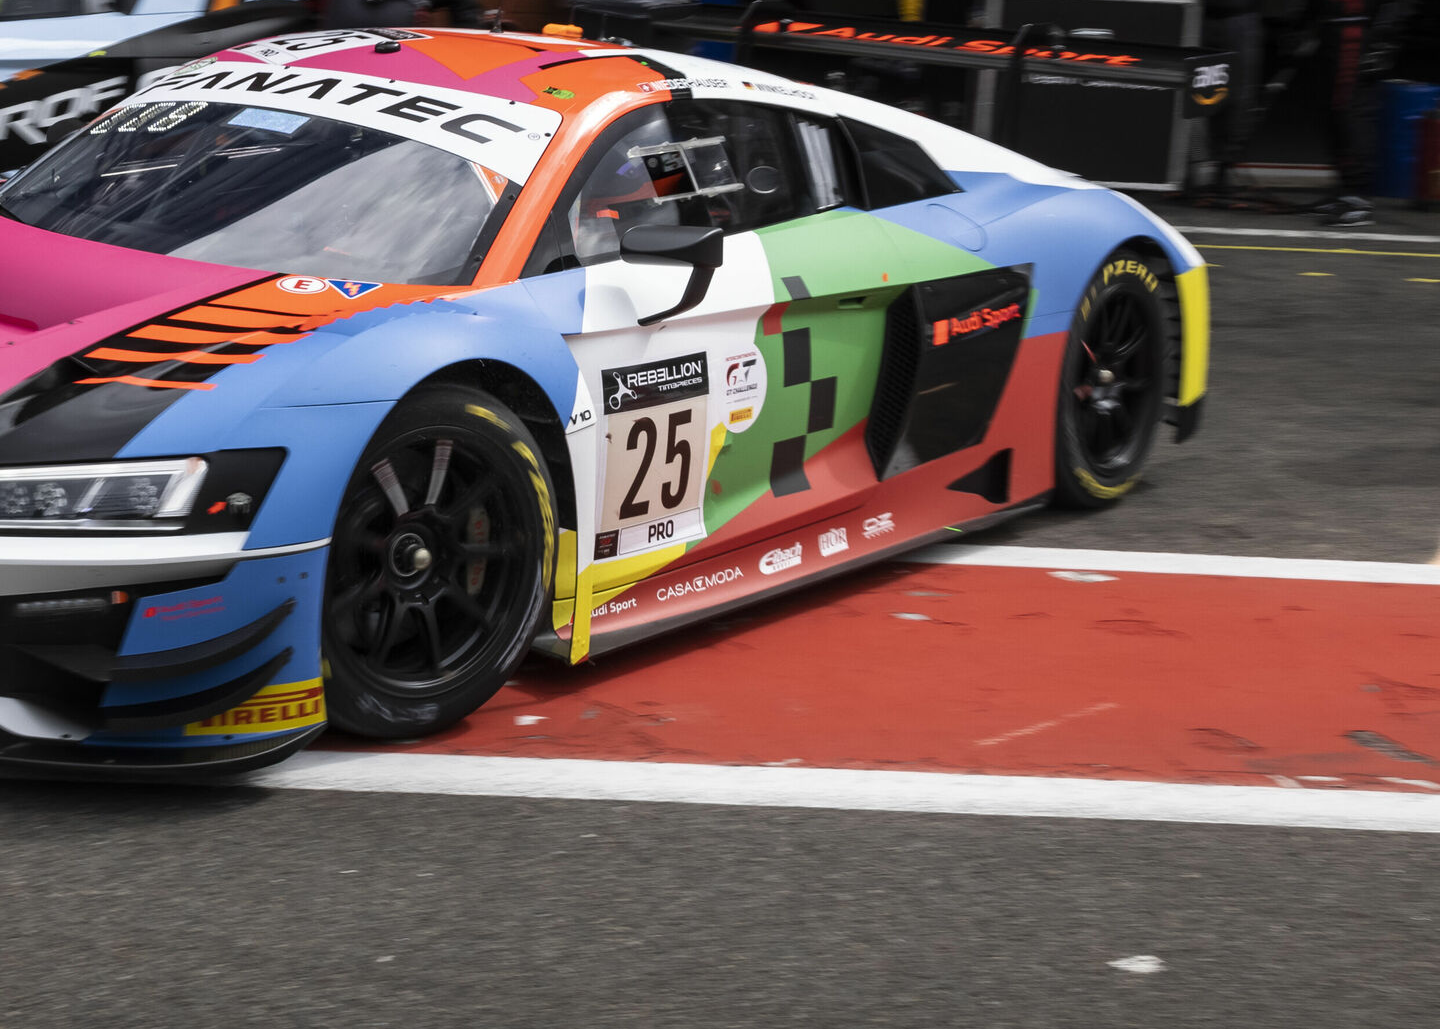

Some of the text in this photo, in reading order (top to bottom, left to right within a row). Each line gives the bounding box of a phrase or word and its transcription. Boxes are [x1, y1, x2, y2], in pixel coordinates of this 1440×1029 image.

[804, 26, 954, 48] Audi
[133, 69, 526, 145] FANATEC
[293, 279, 312, 290] E
[950, 303, 1021, 336] Audi Sport
[619, 409, 694, 521] 25
[648, 519, 674, 544] PRO
[589, 597, 637, 617] udi Sport
